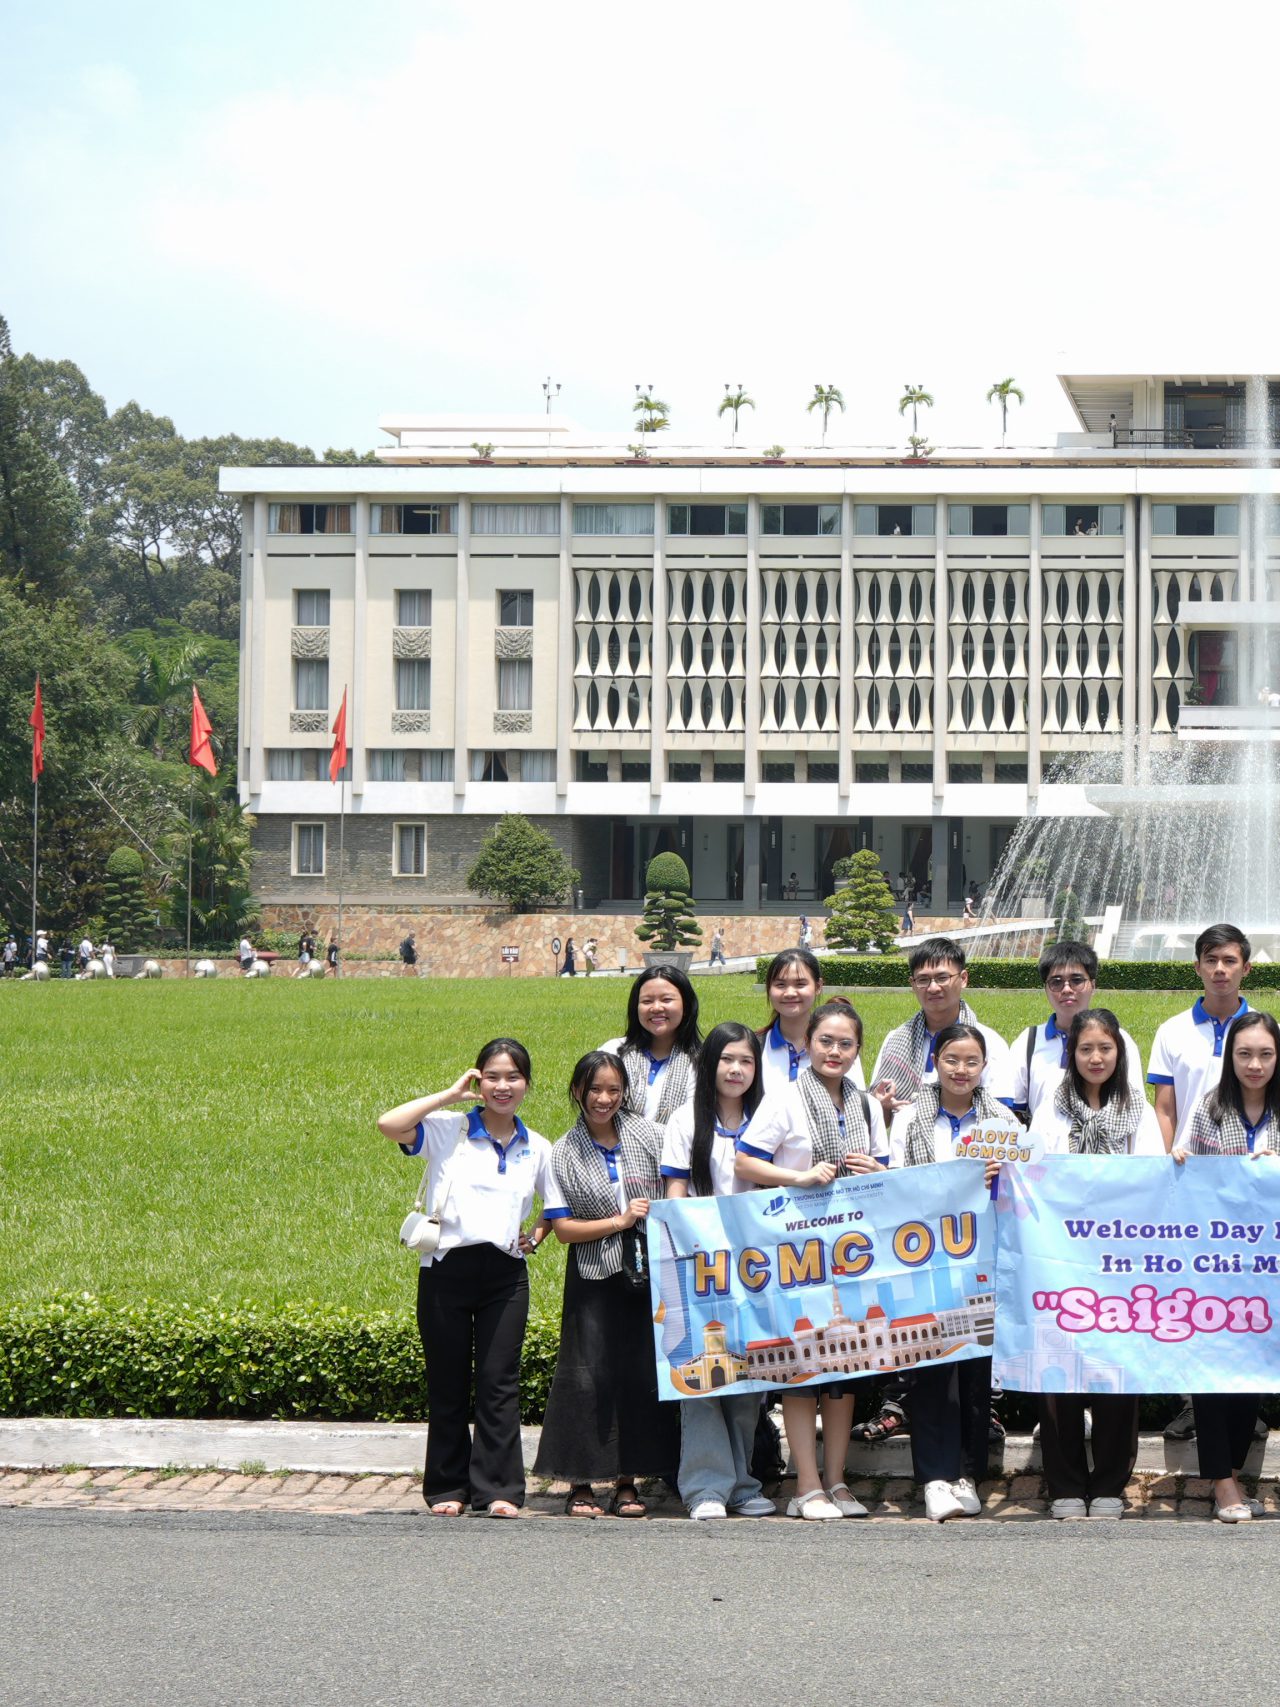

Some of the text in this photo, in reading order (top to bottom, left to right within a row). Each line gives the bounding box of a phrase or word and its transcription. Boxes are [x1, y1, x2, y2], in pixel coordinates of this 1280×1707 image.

[970, 1129, 1018, 1145] I LOVE
[956, 1143, 1031, 1162] HCMCOU
[785, 1210, 864, 1232] WELCOME TO
[1064, 1220, 1199, 1239] Welcome
[1210, 1221, 1264, 1243] Day
[694, 1211, 977, 1297] HCMC OU
[1102, 1255, 1132, 1272] In
[1144, 1255, 1182, 1273] Ho
[1193, 1254, 1242, 1273] Chi
[1033, 1284, 1273, 1343] "Saigon
